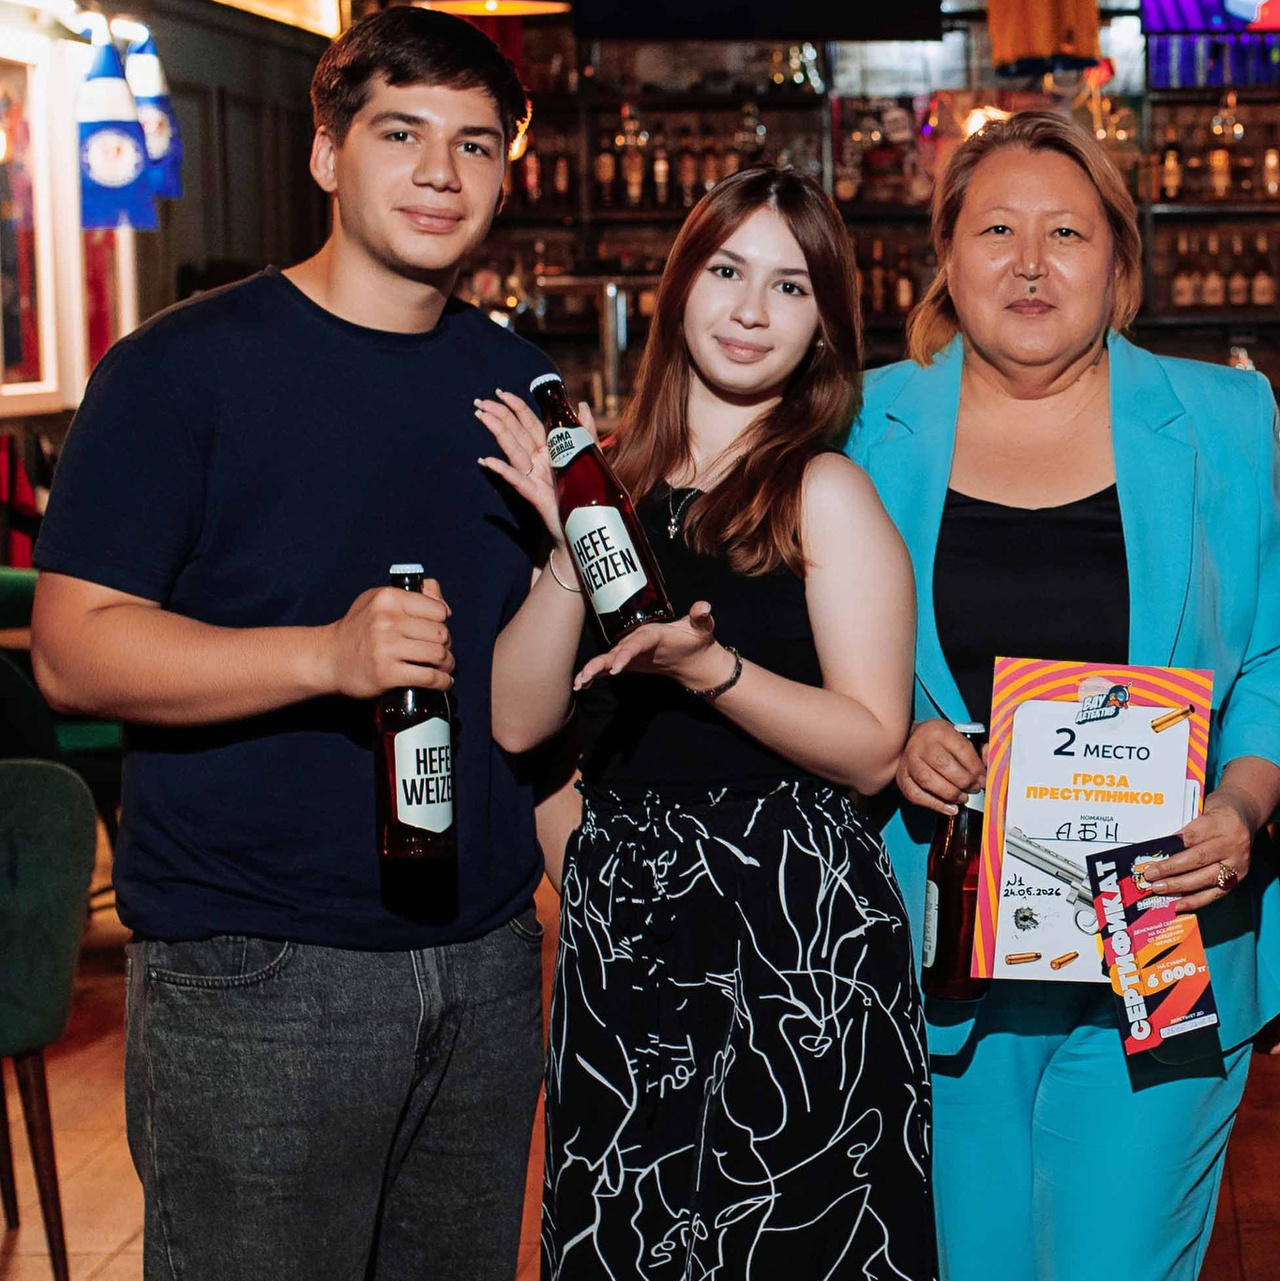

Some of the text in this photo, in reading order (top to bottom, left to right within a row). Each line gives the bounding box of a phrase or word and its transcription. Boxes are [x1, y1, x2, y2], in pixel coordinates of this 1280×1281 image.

[573, 526, 615, 567] HEFE
[1053, 728, 1150, 761] 2 МЕСТО
[402, 775, 452, 806] WEIZE
[1072, 773, 1129, 788] ГРОЗА
[1026, 786, 1165, 805] ПРЕСТУПНИКОВ
[1080, 814, 1114, 822] КОМАНДА
[1095, 860, 1152, 1041] СЕРТИФИКАТ
[1147, 973, 1159, 988] 6
[1161, 962, 1196, 983] 000
